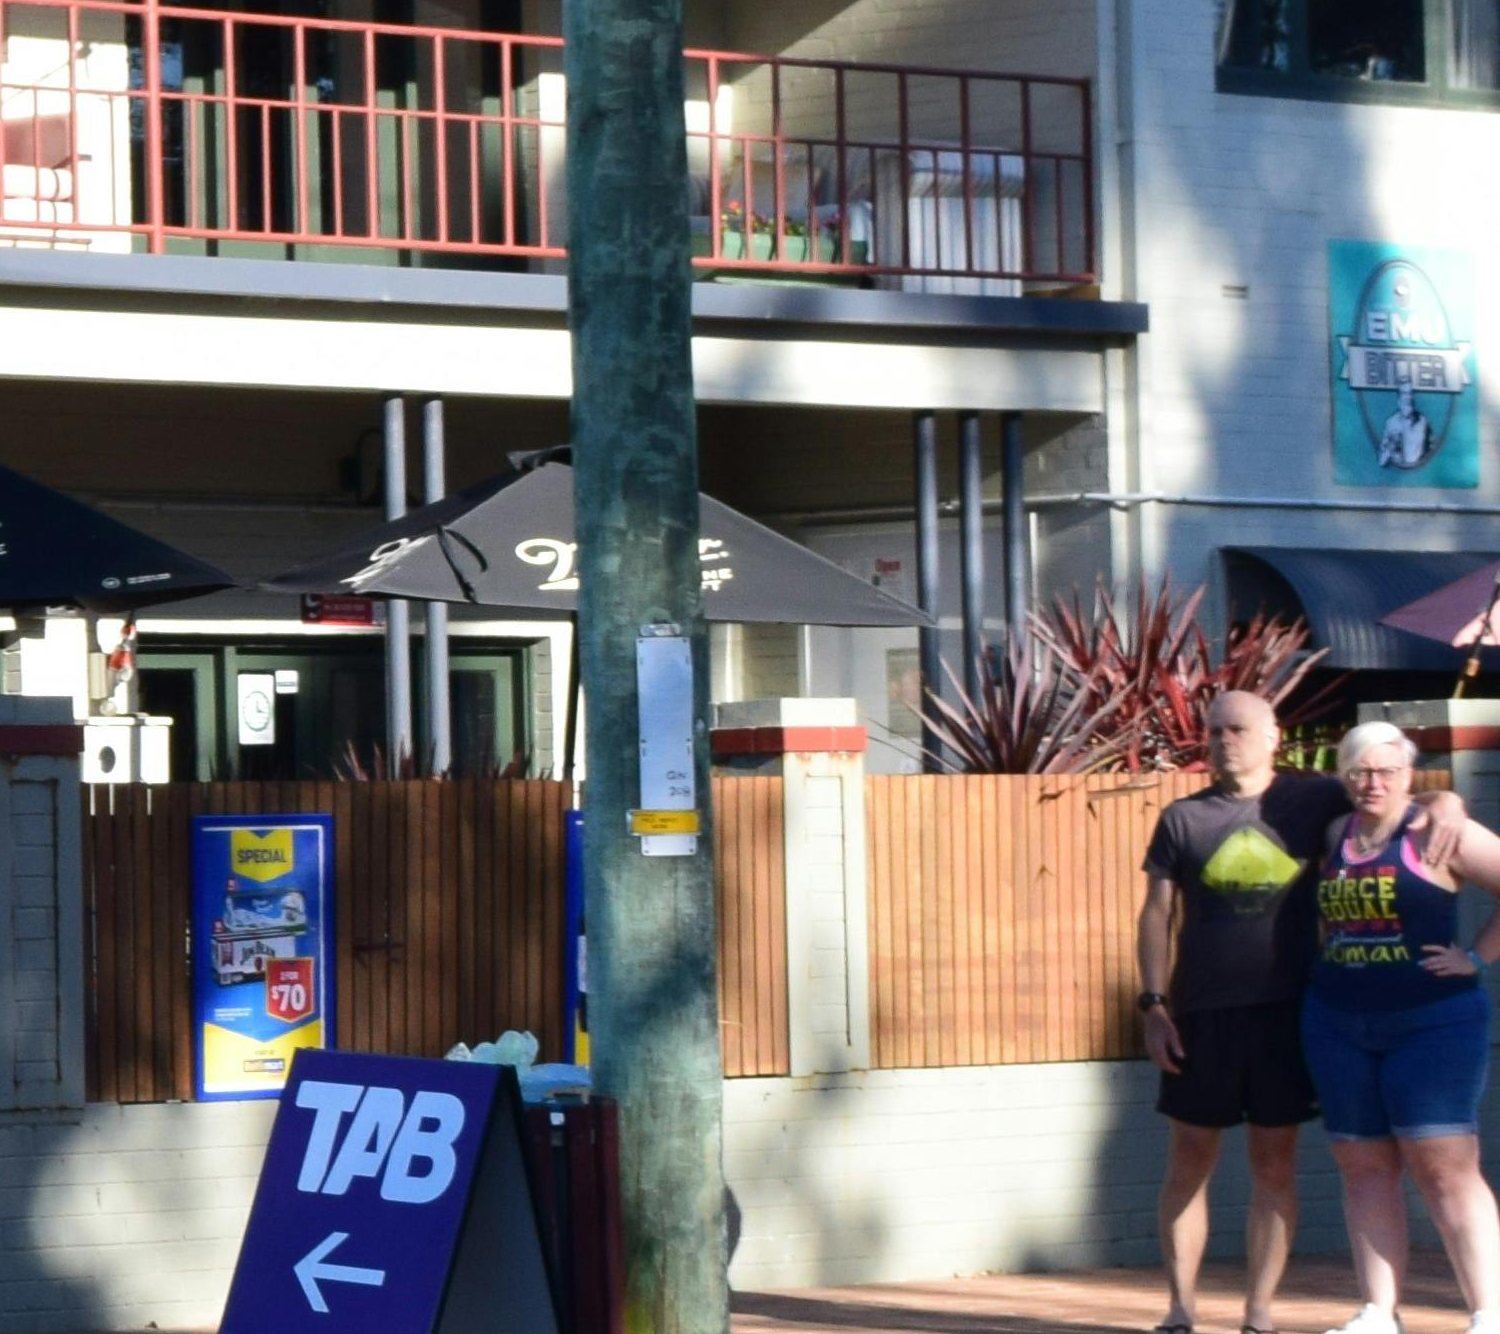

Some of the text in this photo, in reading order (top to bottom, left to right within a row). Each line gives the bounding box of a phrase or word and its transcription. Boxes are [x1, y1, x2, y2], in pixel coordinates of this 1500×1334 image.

[1367, 311, 1445, 345] EMU
[1364, 351, 1448, 388] BITTER
[237, 848, 287, 863] SPECIAL
[1318, 876, 1397, 900] FORCE
[1320, 900, 1398, 922] EQUAL
[271, 983, 307, 1012] $70
[295, 1079, 466, 1205] TAB
